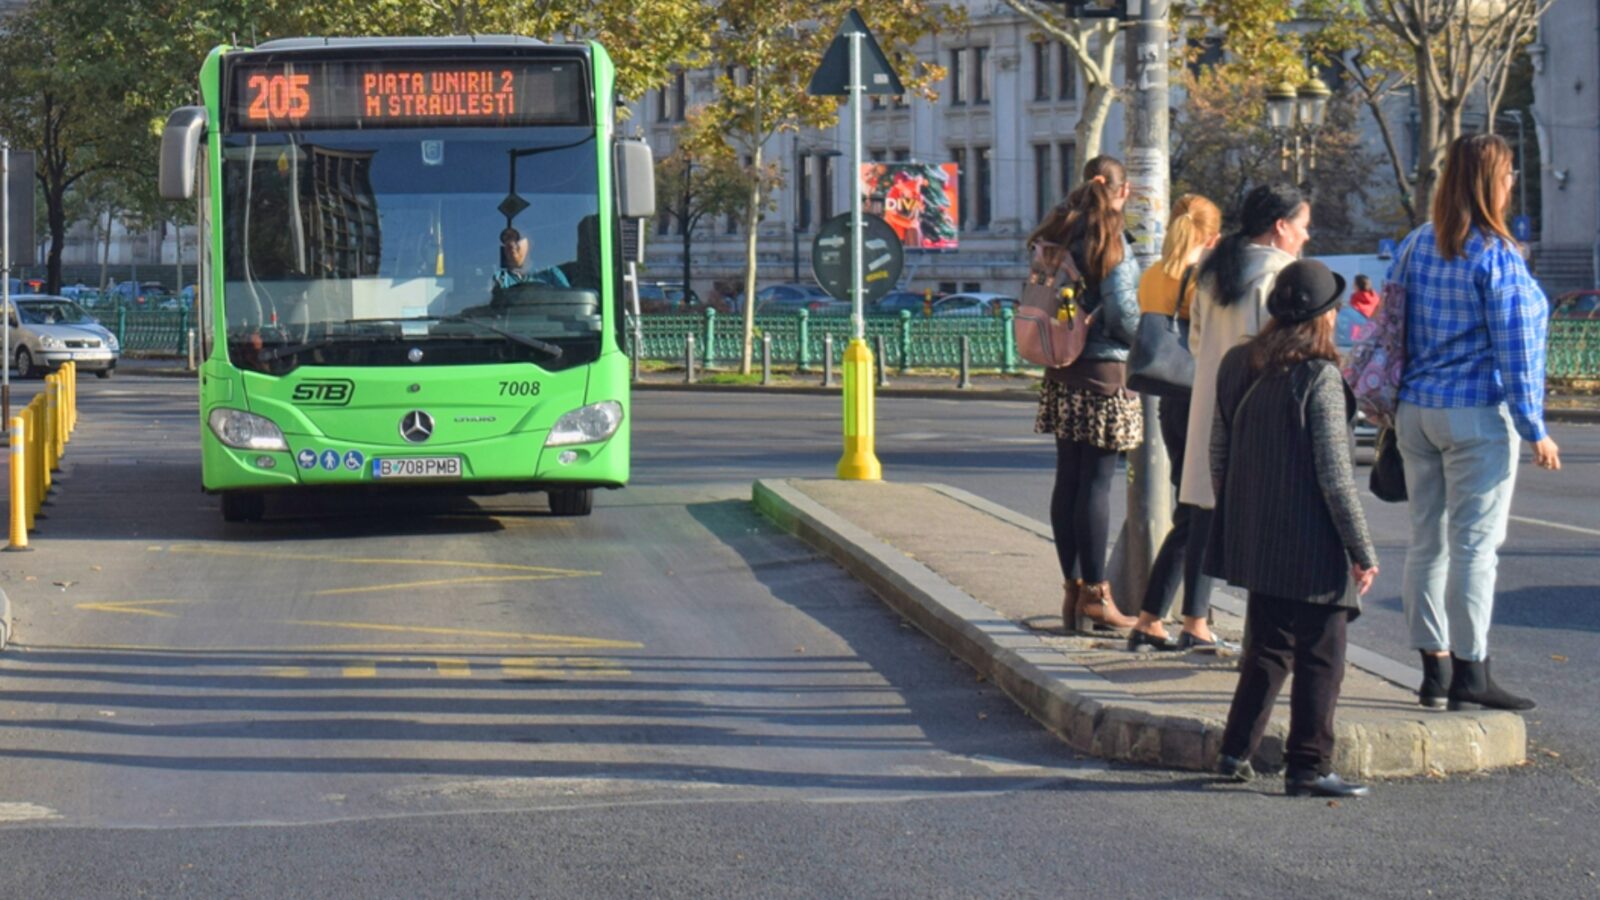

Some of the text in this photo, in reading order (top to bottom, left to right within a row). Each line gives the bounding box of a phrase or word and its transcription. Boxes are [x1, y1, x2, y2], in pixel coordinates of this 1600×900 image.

[364, 70, 514, 94] PIATA UNIRII 2
[248, 75, 310, 118] 205
[366, 93, 514, 116] M STRAULESTI
[292, 383, 348, 400] STB
[499, 381, 541, 396] 7008
